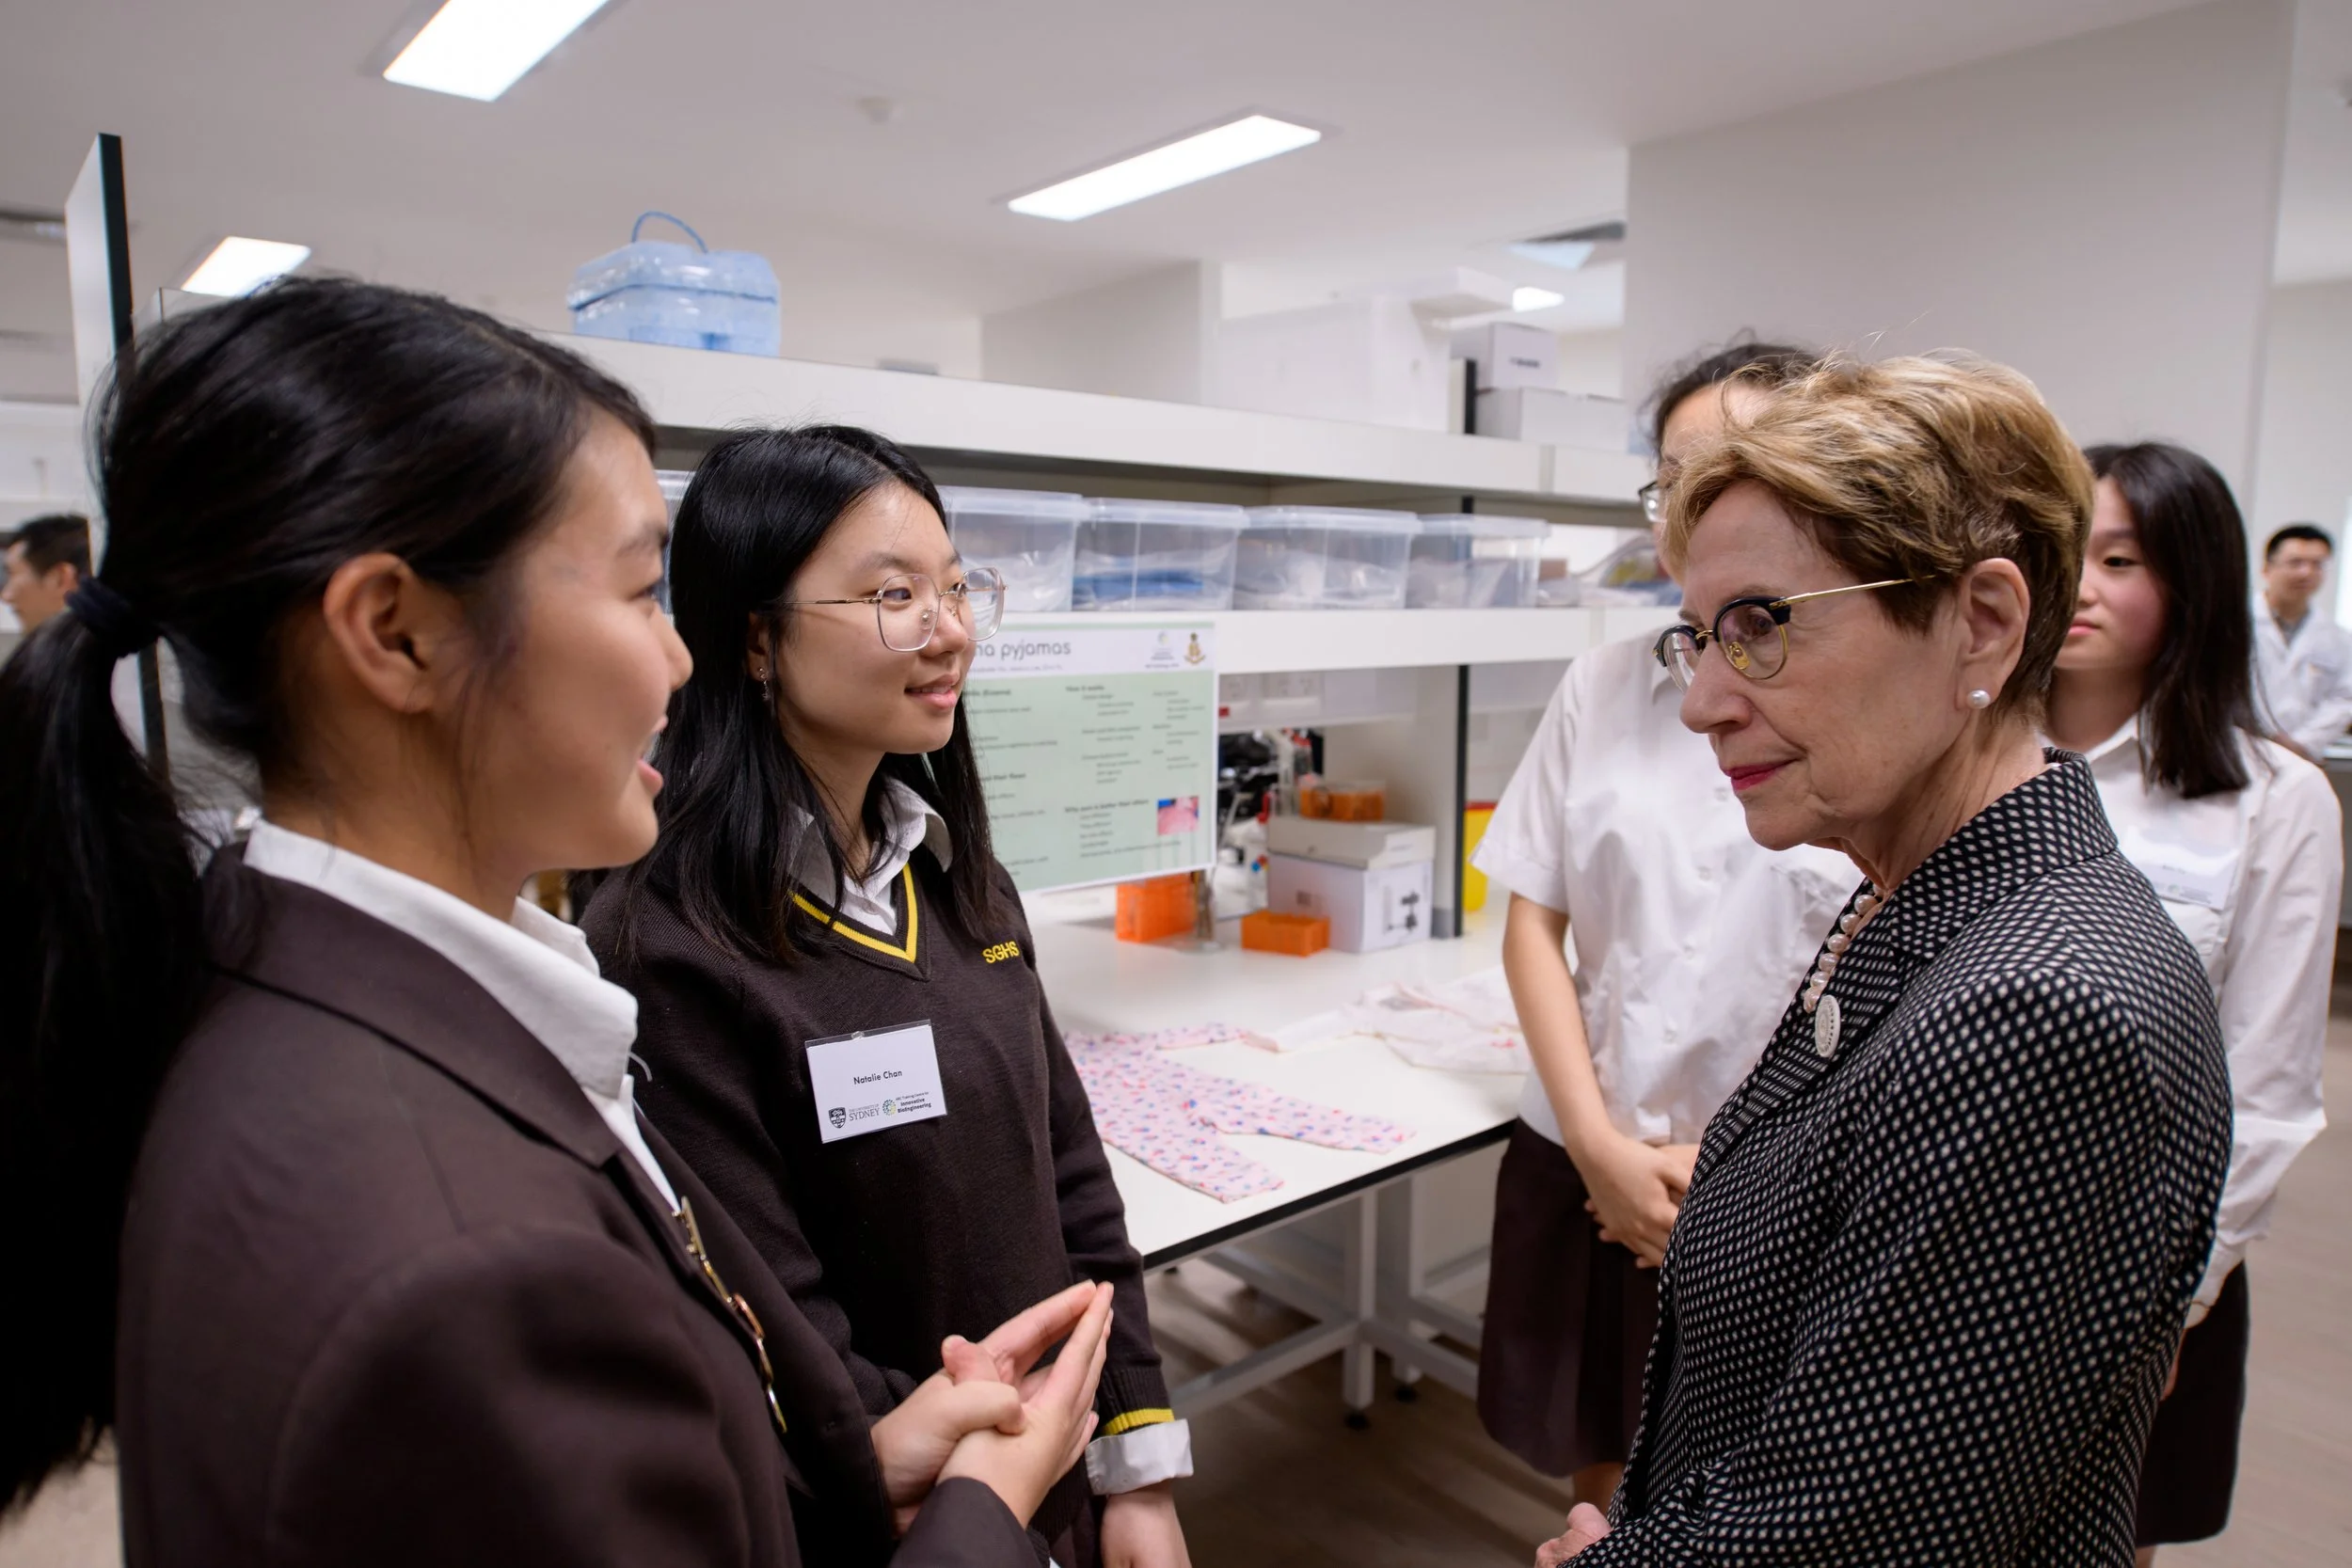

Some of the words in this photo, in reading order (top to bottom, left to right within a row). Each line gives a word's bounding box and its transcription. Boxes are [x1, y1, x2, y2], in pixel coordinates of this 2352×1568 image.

[1000, 639, 1072, 661] pyjamas
[982, 941, 1020, 964] SGHS
[853, 1073, 882, 1085] Natalie
[882, 1070, 903, 1080] Chan
[900, 1098, 925, 1107] Innovative
[849, 1107, 881, 1121] SYDNEY
